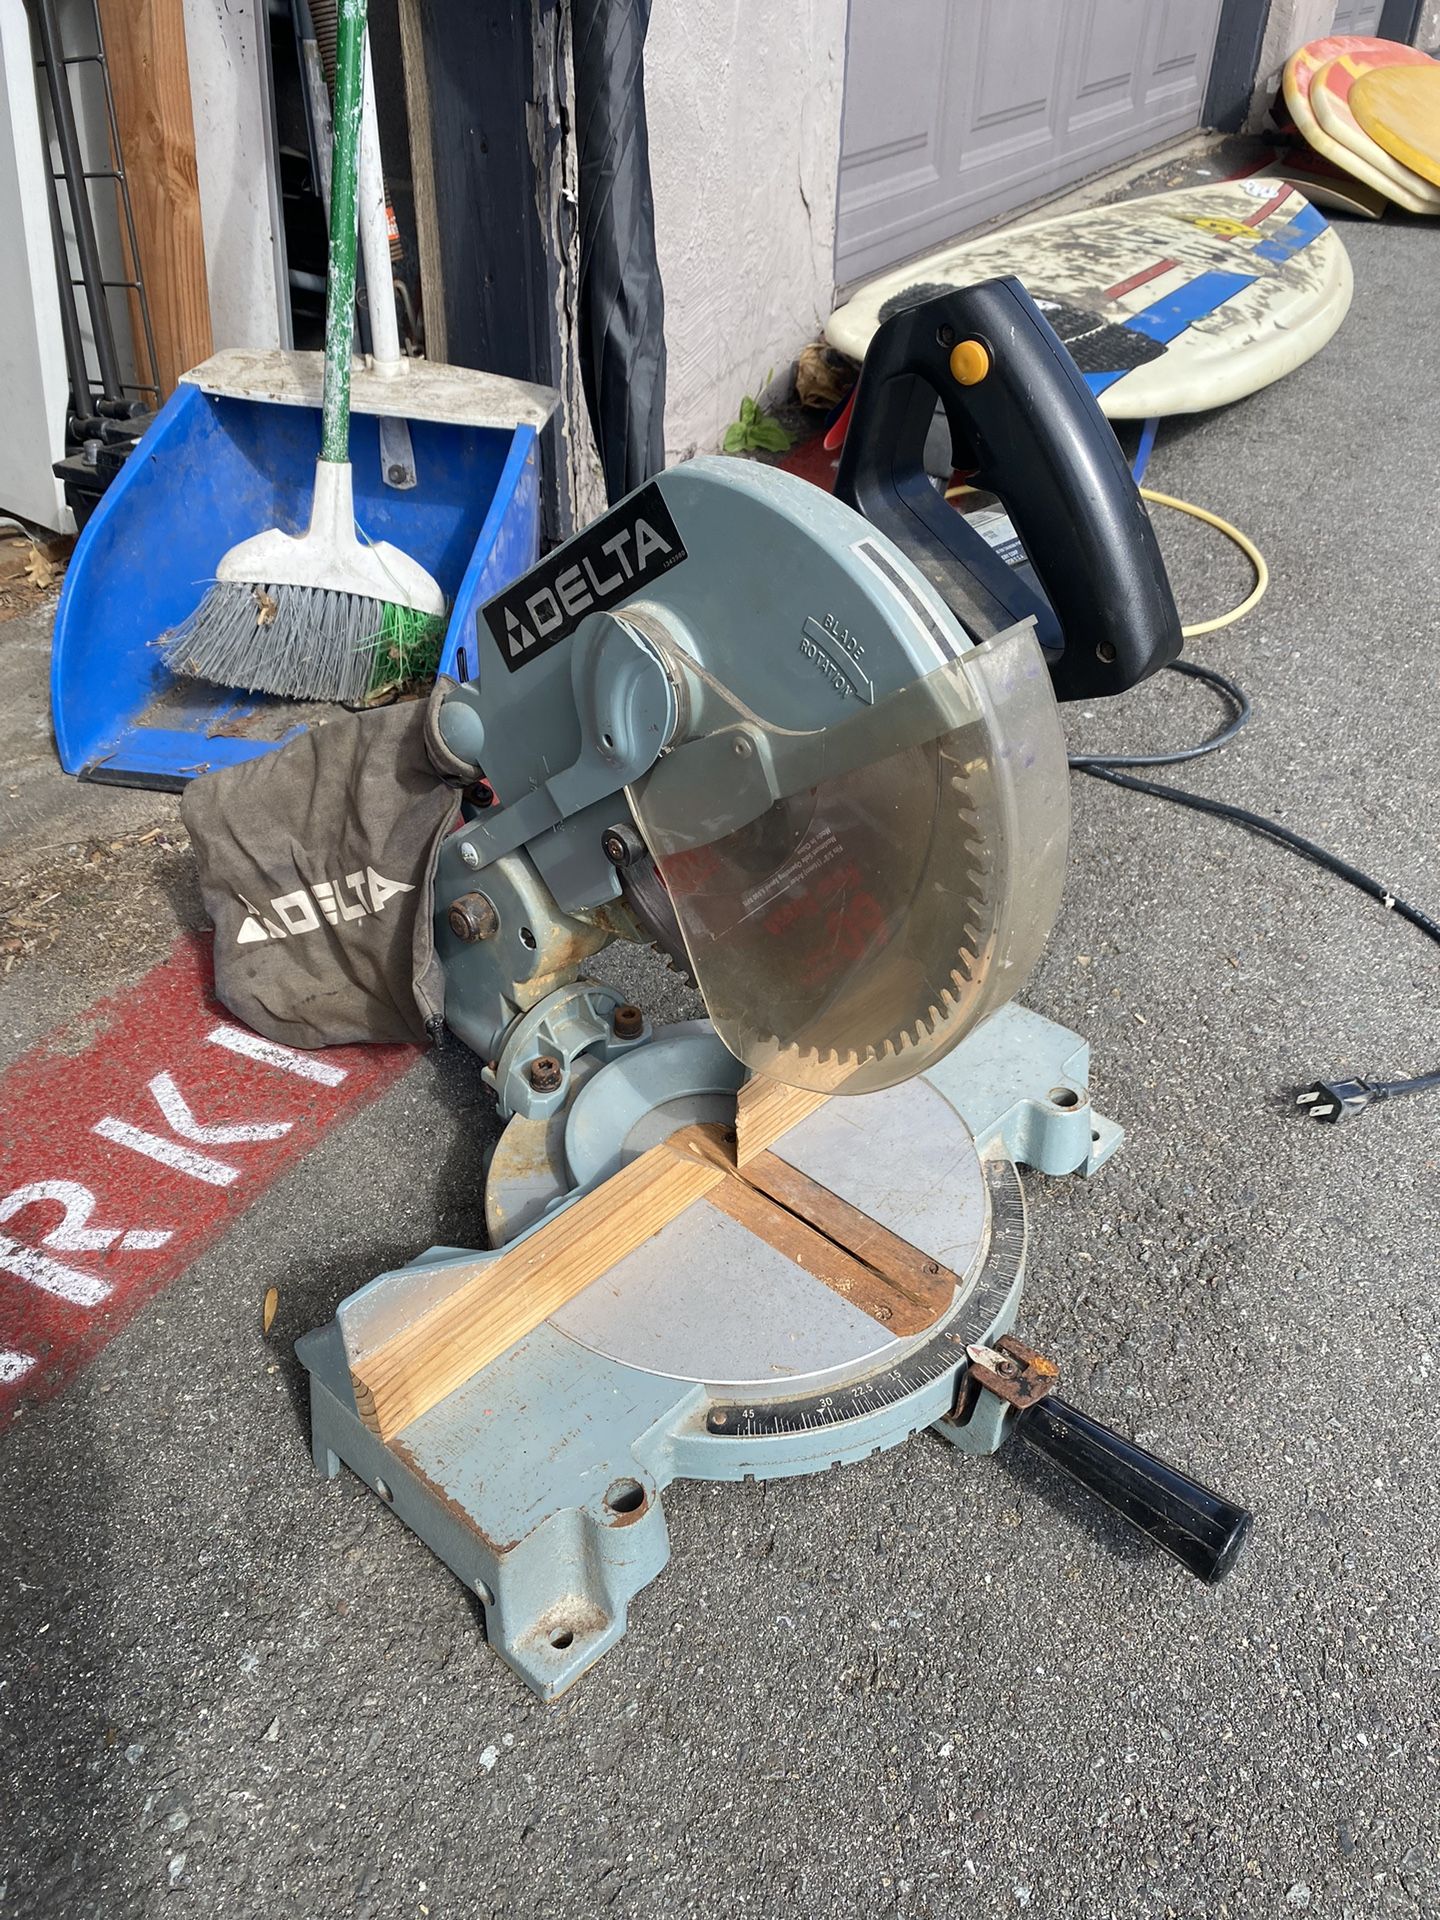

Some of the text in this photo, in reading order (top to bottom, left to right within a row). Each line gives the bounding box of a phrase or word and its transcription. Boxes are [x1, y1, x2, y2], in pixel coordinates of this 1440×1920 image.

[525, 518, 672, 638] DELTA
[801, 638, 853, 699] ROTATION
[825, 613, 865, 660] BLADE
[270, 866, 416, 935] DELTA
[741, 1408, 755, 1419] 45
[820, 1397, 833, 1408] 30
[852, 1383, 873, 1398] 22.5
[888, 1369, 901, 1382] 15
[978, 1282, 990, 1293] 15
[988, 1254, 1000, 1270] 22.5
[995, 1231, 1006, 1241] 30
